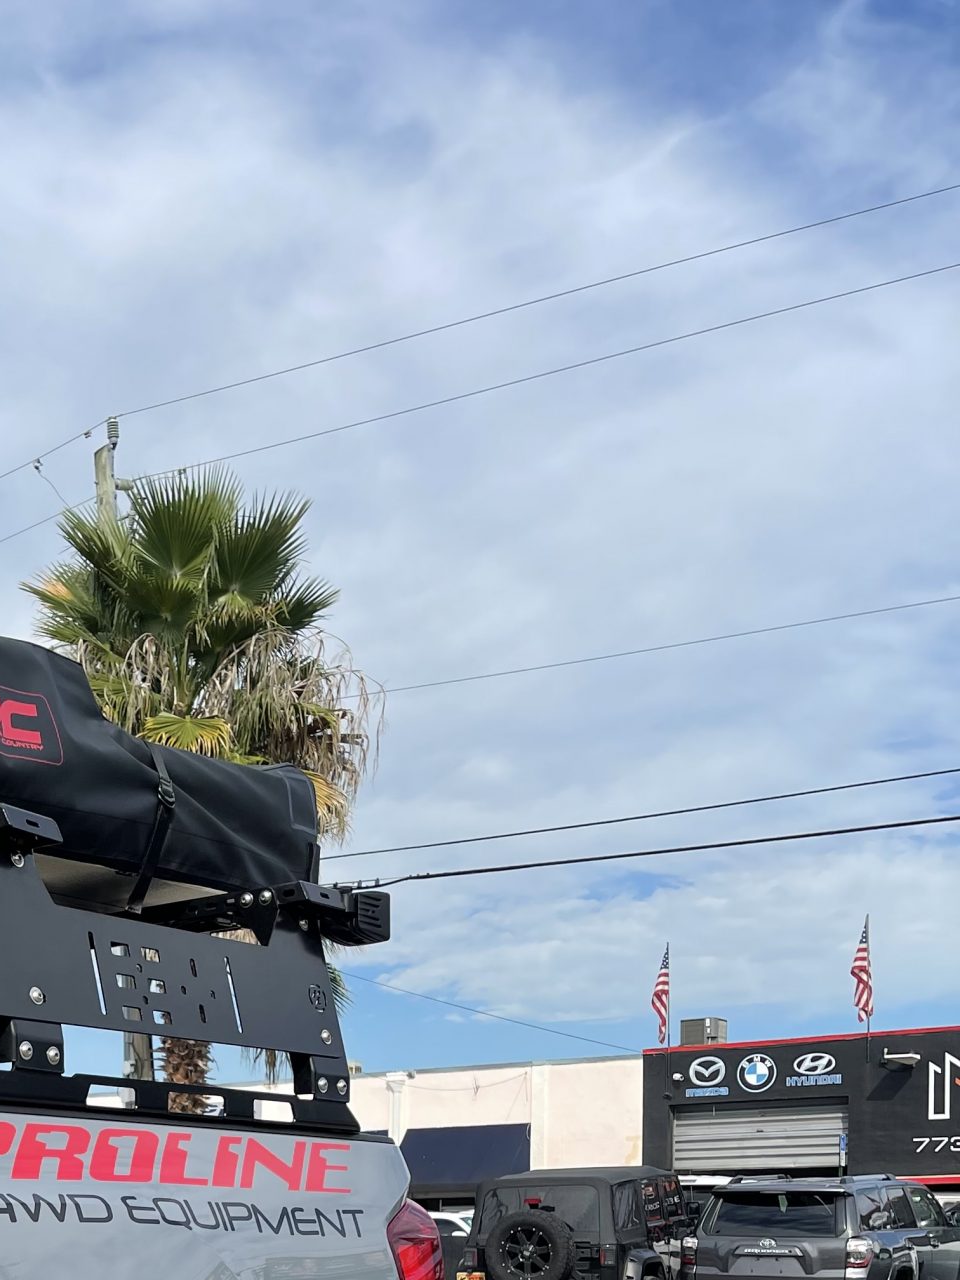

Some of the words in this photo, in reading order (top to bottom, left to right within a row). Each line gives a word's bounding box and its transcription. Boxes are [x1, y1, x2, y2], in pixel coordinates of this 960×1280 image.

[1, 738, 44, 752] COUNTRY
[785, 1074, 842, 1087] HYUNDAI
[120, 1195, 365, 1239] EQUIPMENT
